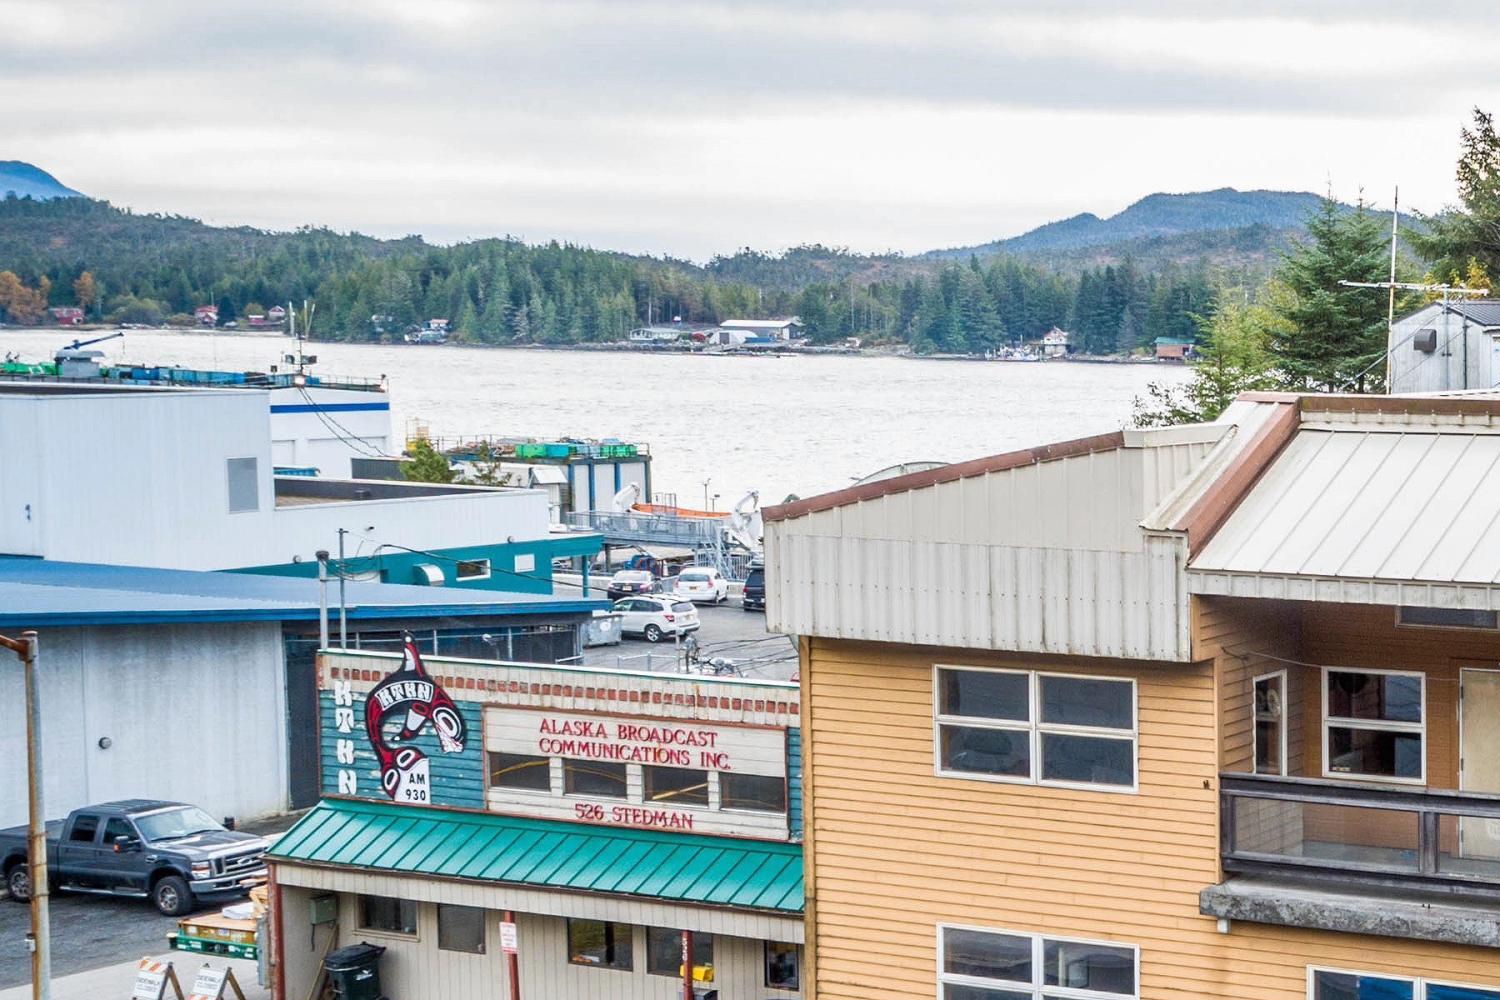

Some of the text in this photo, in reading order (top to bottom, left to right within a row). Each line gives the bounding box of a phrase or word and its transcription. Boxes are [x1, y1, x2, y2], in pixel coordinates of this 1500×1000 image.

[379, 682, 431, 707] KTHN
[540, 718, 718, 748] ALASKA BROADCAST
[539, 737, 731, 769] COMMUNICATIONS INC.
[409, 773, 425, 785] AM
[405, 789, 426, 801] 930
[575, 803, 693, 829] 526 STEDMAN
